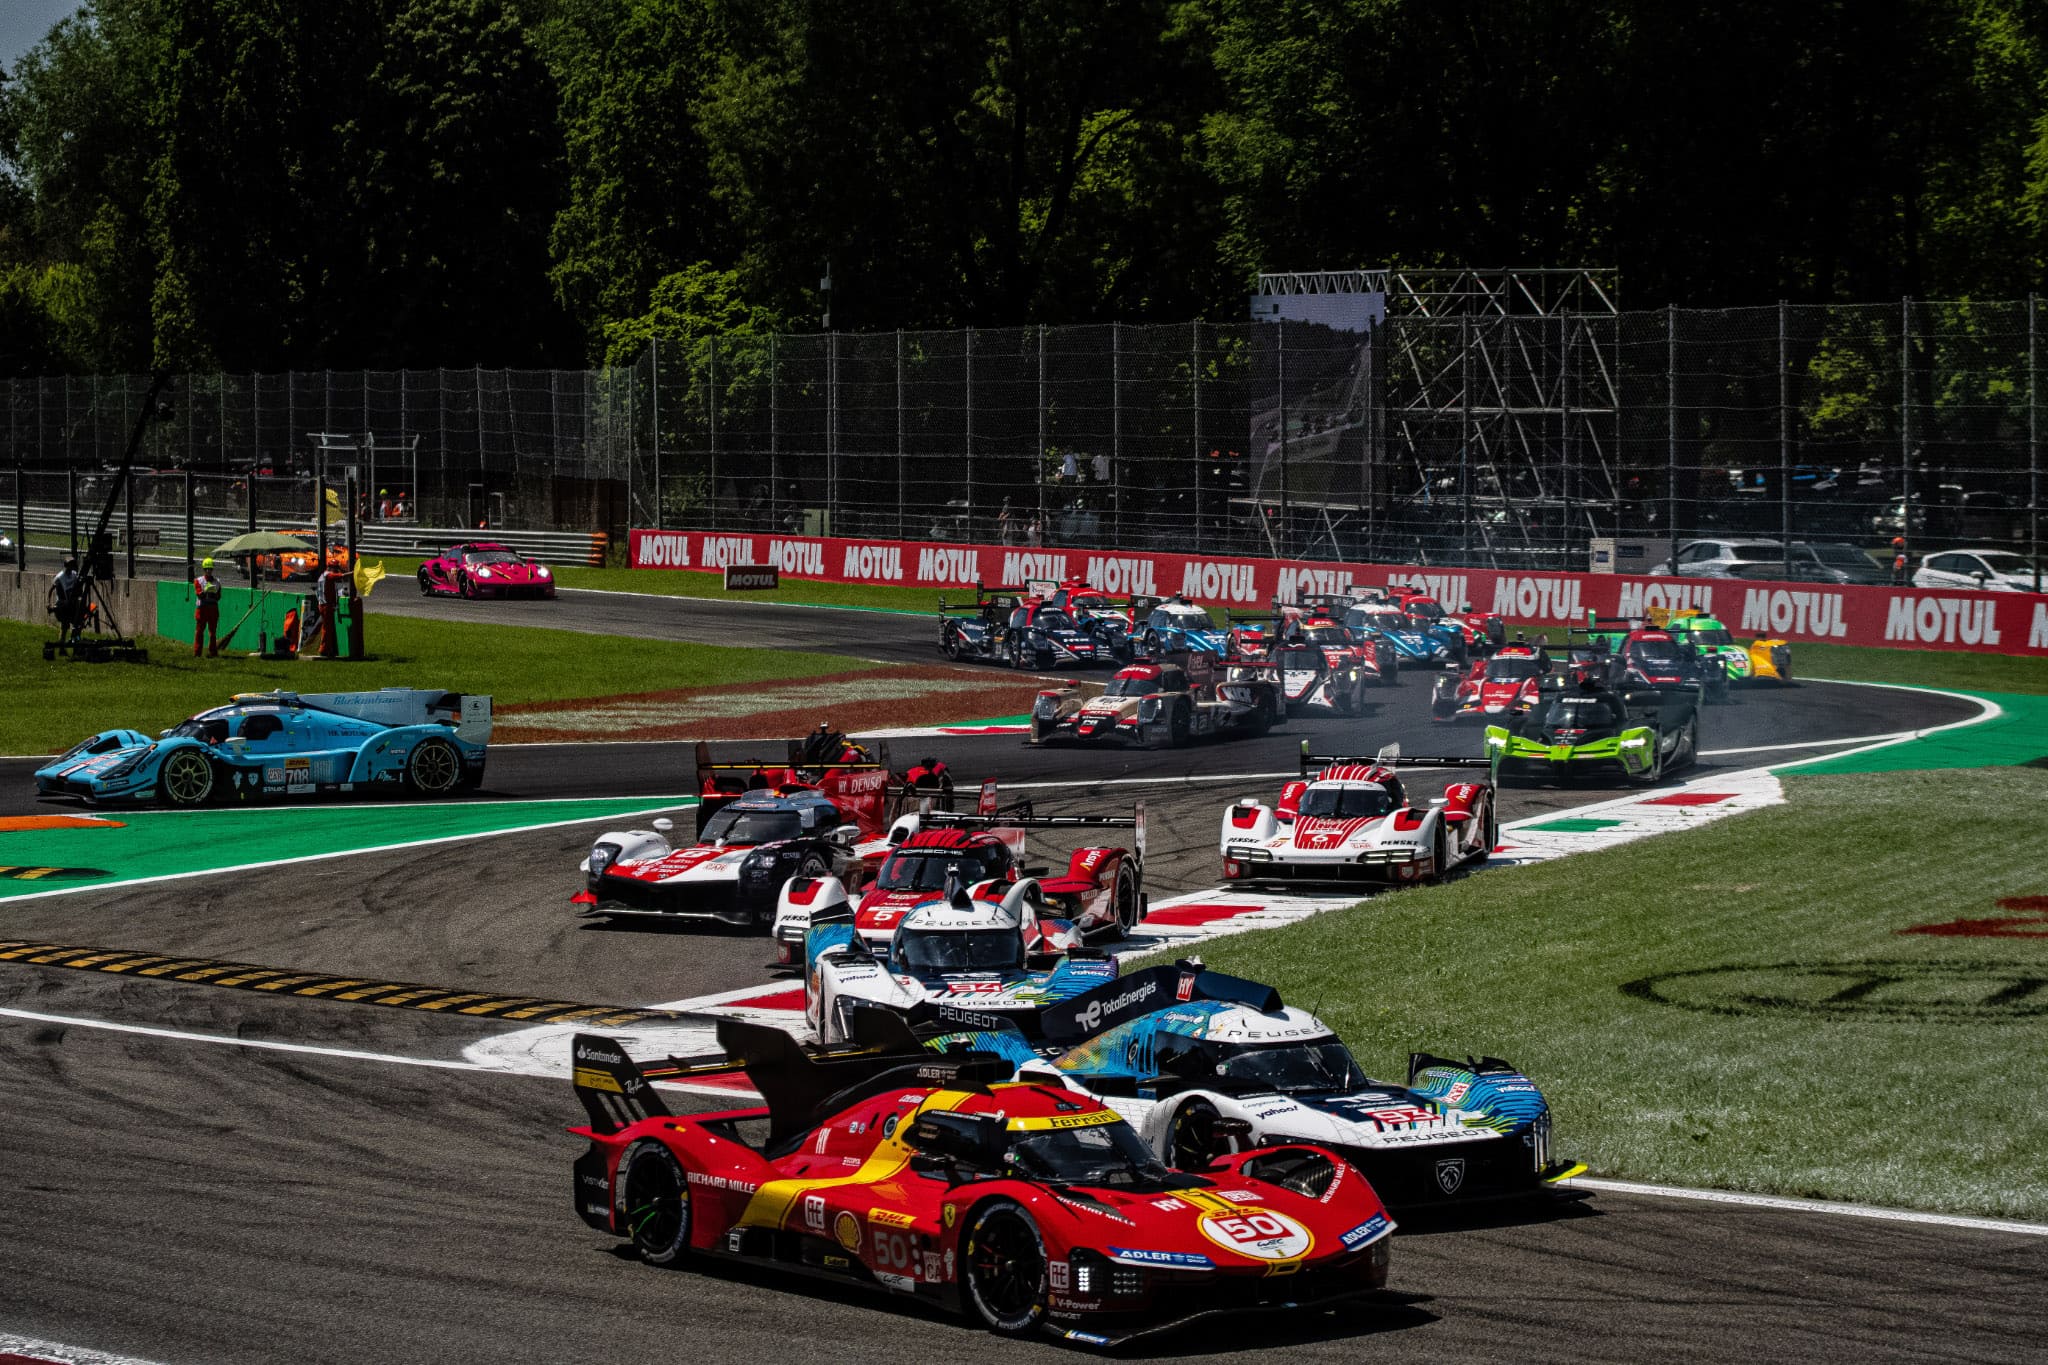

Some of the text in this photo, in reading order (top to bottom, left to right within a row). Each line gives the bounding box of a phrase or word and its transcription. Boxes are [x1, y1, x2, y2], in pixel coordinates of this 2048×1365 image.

[638, 535, 690, 566] MOTUL
[702, 536, 755, 568] MOTUL
[768, 540, 824, 575] MOTUL
[842, 545, 903, 580] MOTUL
[917, 548, 980, 583] MOTUL
[1002, 552, 1067, 585] MOTUL
[729, 574, 776, 586] MOTUL
[1087, 556, 1157, 596] MOTUL
[1182, 561, 1257, 602] MOTUL
[1277, 567, 1353, 605] MOTUL
[1492, 577, 1585, 619] MOTUL
[1741, 588, 1847, 637] MOTUL
[1885, 596, 2001, 646] MOTUL
[286, 768, 309, 784] 708
[851, 776, 882, 794] DENSO
[1311, 833, 1328, 844] 6
[1079, 850, 1101, 872] Ansys
[873, 911, 893, 921] 5
[952, 983, 1000, 992] 94
[1179, 977, 1194, 996] HY
[1102, 981, 1157, 1016] TotalEnergies
[939, 1006, 999, 1029] PEUGEOT
[586, 1048, 621, 1064] Santander
[1049, 1112, 1113, 1127] Ferrari
[1256, 1105, 1299, 1120] yahoo!
[1374, 1107, 1431, 1123] 93
[1383, 1128, 1490, 1144] PEUGEOT
[687, 1171, 756, 1194] RICHARD MILLE
[1056, 1196, 1137, 1227] RICHARD MILLE
[1151, 1199, 1188, 1212] HY
[874, 1211, 907, 1224] DHL
[1217, 1216, 1284, 1239] 50
[874, 1231, 906, 1269] 50
[1119, 1250, 1171, 1261] ADLER
[1056, 1298, 1100, 1310] V-Power
